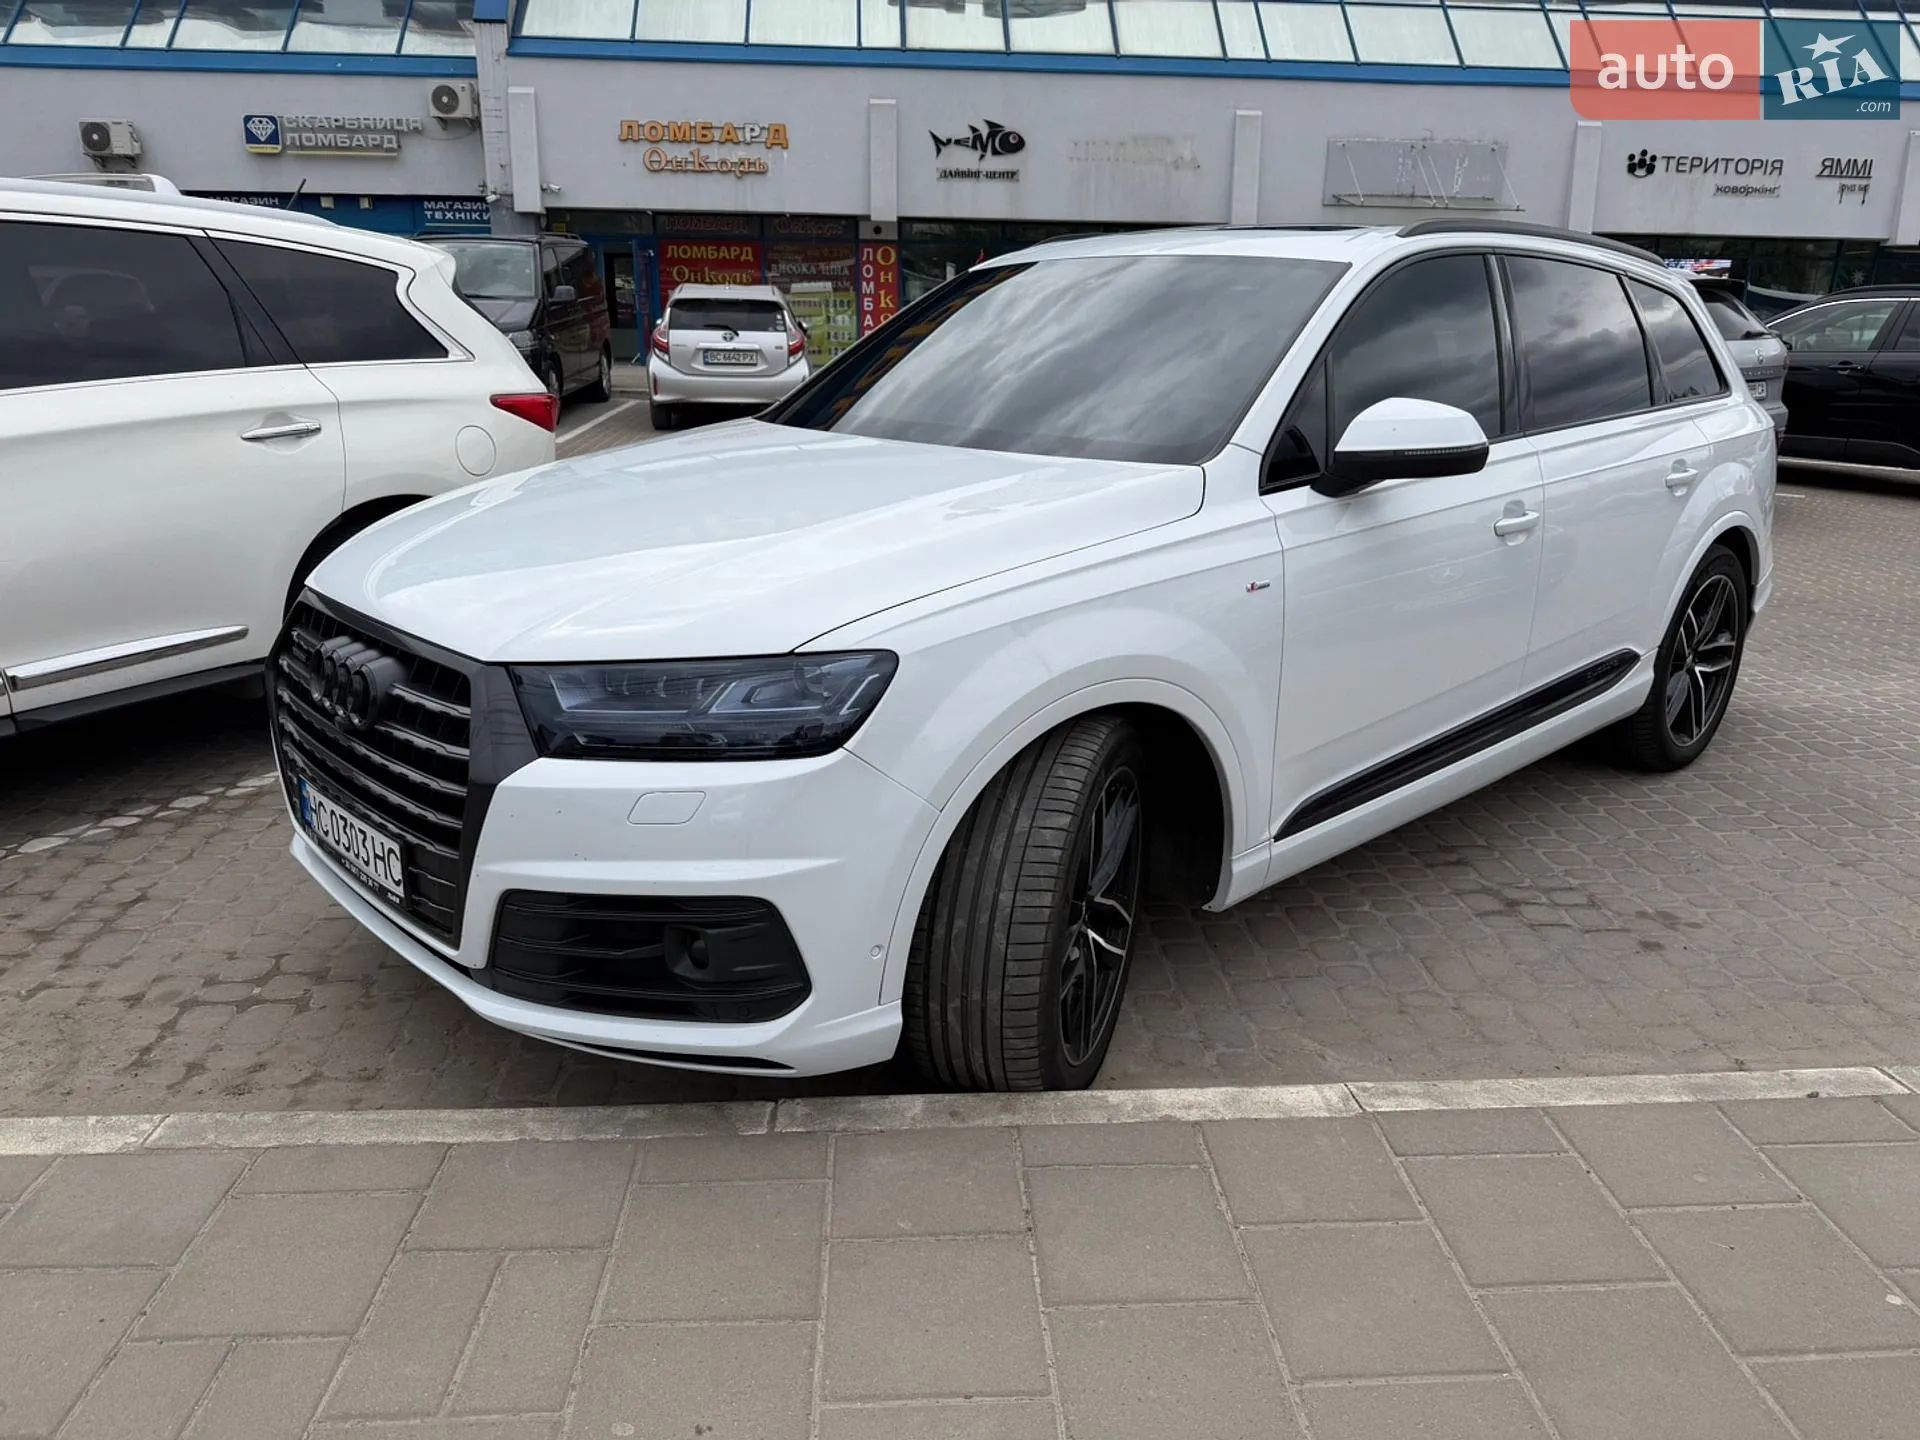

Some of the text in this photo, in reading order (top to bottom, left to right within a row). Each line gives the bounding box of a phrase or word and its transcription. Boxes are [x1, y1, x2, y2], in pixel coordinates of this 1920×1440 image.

[284, 116, 422, 132] СКАРБНИЦЯ
[285, 133, 398, 149] ЛОМБАРД
[618, 119, 789, 149] ЛОМБАРД
[1661, 155, 1785, 176] ТЕРИТОРІЯ
[1819, 157, 1873, 177] ЯММІ
[1715, 183, 1780, 196] коворкінг
[666, 245, 754, 262] ЛОМБАРД
[330, 809, 370, 867] 0303
[371, 835, 402, 887] HC
